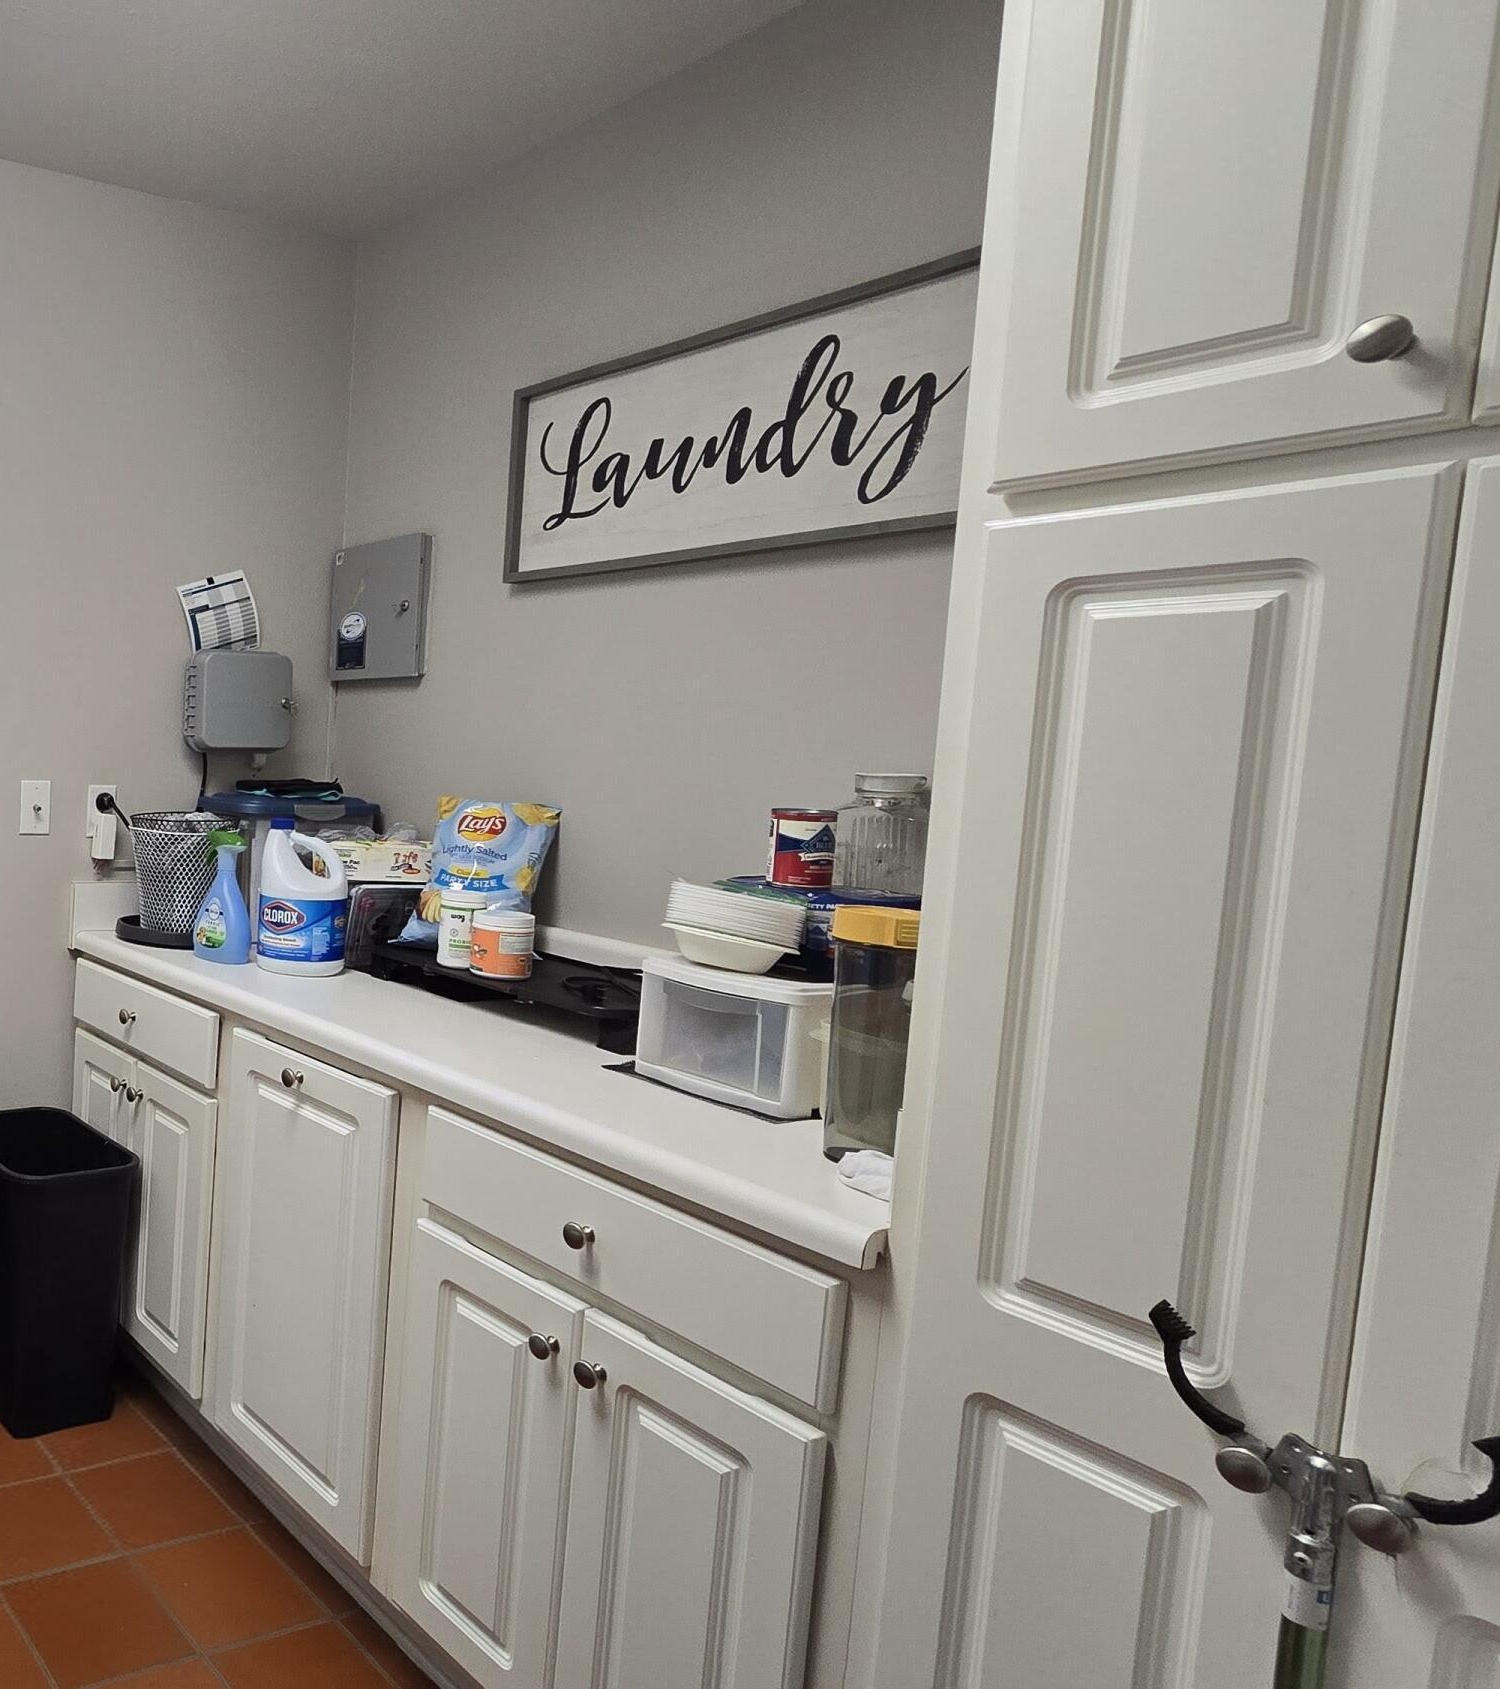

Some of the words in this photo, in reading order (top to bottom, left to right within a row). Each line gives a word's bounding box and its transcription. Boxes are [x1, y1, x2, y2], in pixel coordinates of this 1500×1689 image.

[540, 334, 970, 531] Laundry
[459, 815, 505, 834] Lay's
[442, 844, 474, 854] Lightly
[475, 845, 508, 861] Salted
[440, 873, 470, 887] PARTY
[472, 879, 498, 888] SIZE
[263, 908, 299, 925] CLOROX
[450, 914, 466, 923] wag
